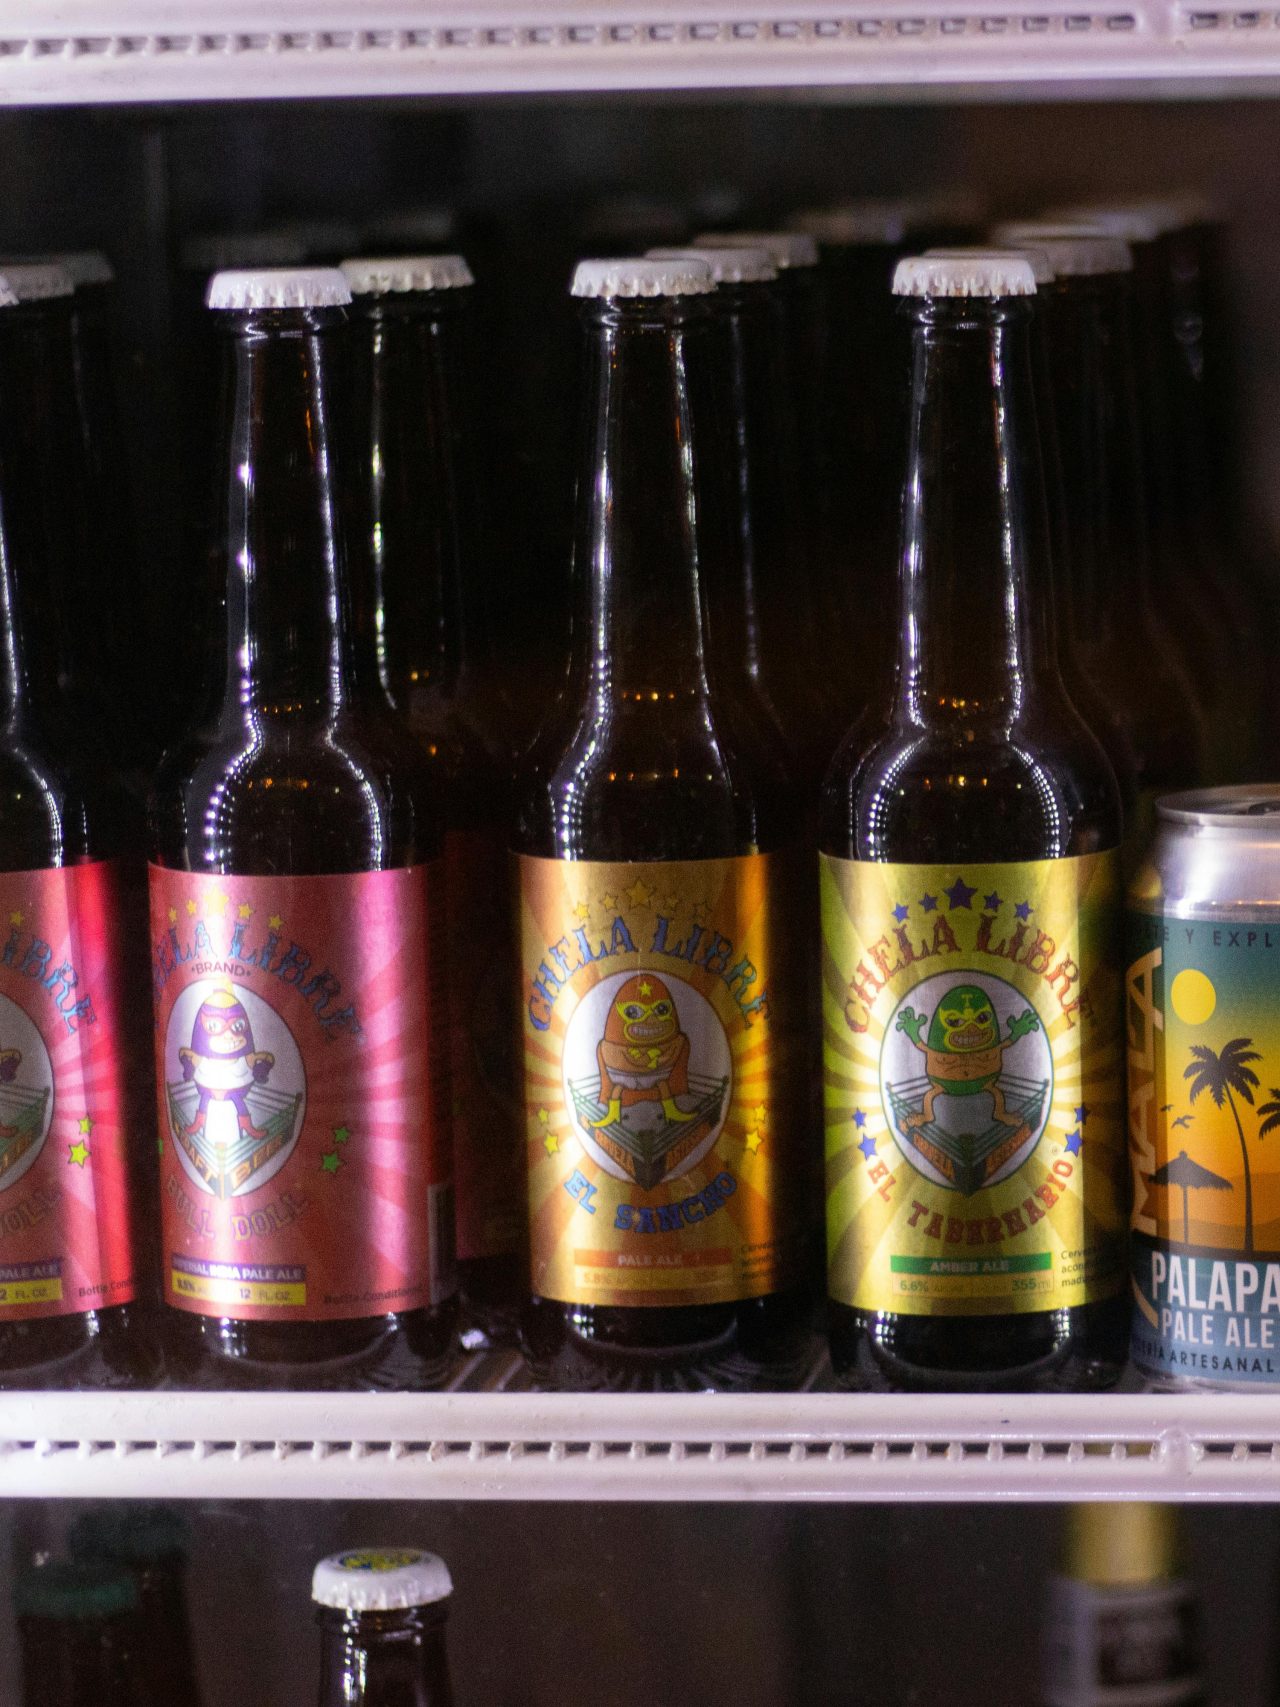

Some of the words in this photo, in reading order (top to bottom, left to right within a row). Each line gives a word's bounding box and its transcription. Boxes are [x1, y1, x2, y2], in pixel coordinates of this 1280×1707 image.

[196, 961, 246, 977] BRAND
[528, 916, 638, 1031] CHELA
[650, 914, 772, 1030] LIBRE
[844, 914, 959, 1033] CHELA
[976, 913, 1094, 1030] LIBRE
[0, 928, 99, 1036] IBRE
[867, 1160, 896, 1202] EL
[564, 1169, 598, 1214] EL
[614, 1171, 738, 1233] SANCHO
[618, 1254, 652, 1266] PALE
[656, 1253, 683, 1266] ALE
[930, 1261, 977, 1273] AMBER
[982, 1261, 1009, 1272] ALE
[242, 1267, 272, 1280] PALE
[276, 1268, 301, 1280] ALE
[240, 1288, 251, 1299] 12
[1012, 1279, 1037, 1291] 355
[1163, 1307, 1214, 1345] PALE
[1226, 1317, 1275, 1348] ALE
[1170, 1351, 1275, 1373] ARTESANAL
